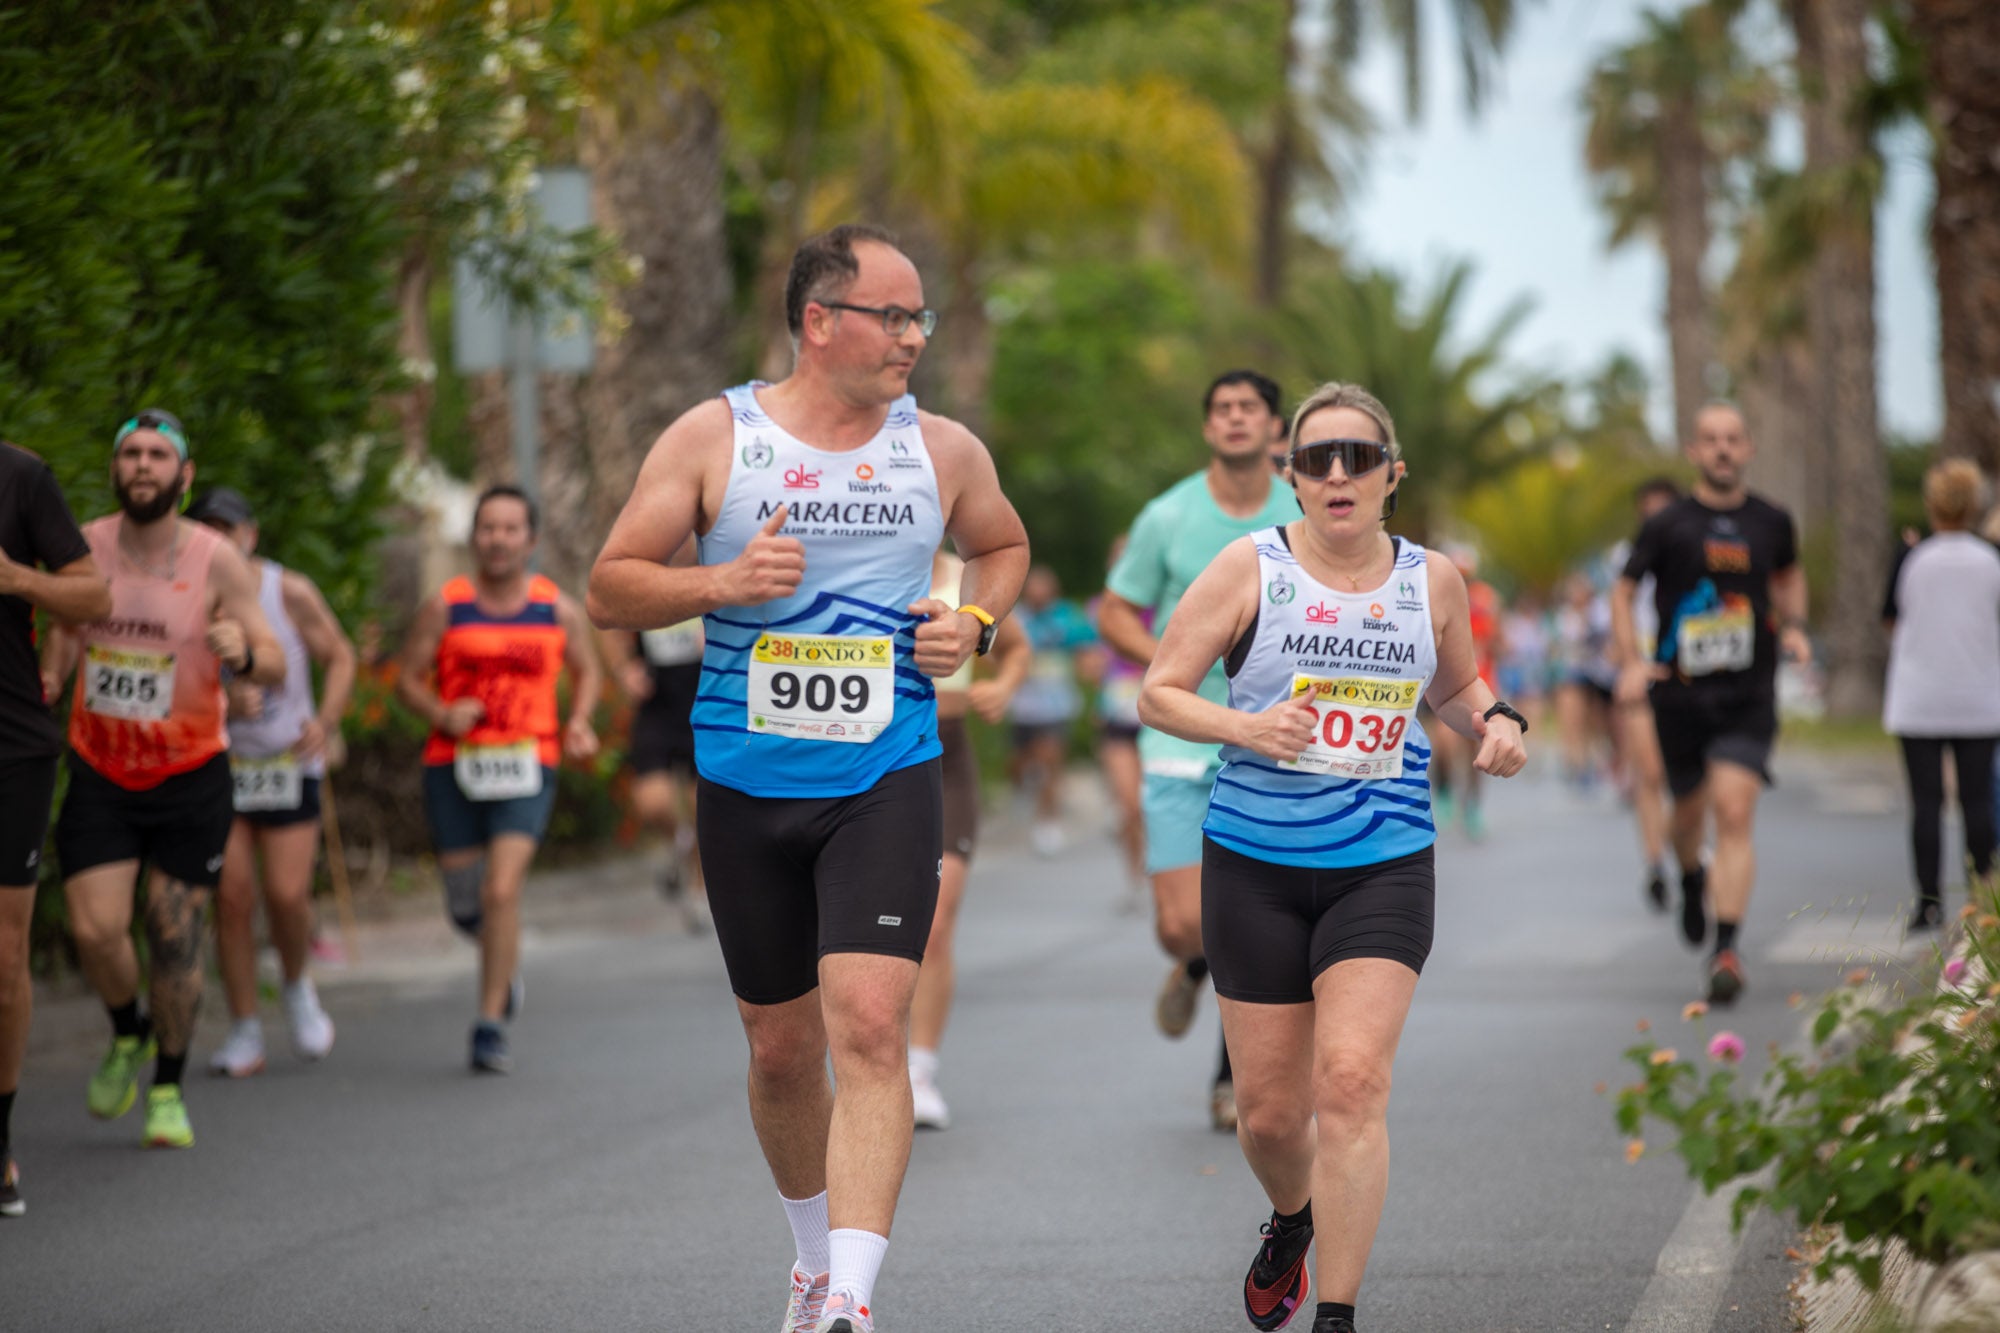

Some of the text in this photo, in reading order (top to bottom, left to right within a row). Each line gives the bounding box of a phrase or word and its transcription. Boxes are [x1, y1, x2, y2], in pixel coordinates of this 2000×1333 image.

[783, 464, 820, 489] als
[756, 501, 915, 525] MARACENA
[812, 528, 826, 536] DE
[830, 528, 898, 538] ATLETISMO
[1305, 601, 1338, 624] als
[770, 640, 793, 658] 38
[826, 640, 860, 648] PREMIO
[1281, 634, 1415, 664] MARACENA
[793, 647, 865, 661] FONDO
[1297, 659, 1402, 675] CLUB DE ATLETISMO
[97, 667, 157, 703] 265
[770, 672, 870, 714] 909
[1313, 682, 1333, 695] 38
[1364, 682, 1396, 690] PREMIO
[1332, 685, 1400, 704] FONDO
